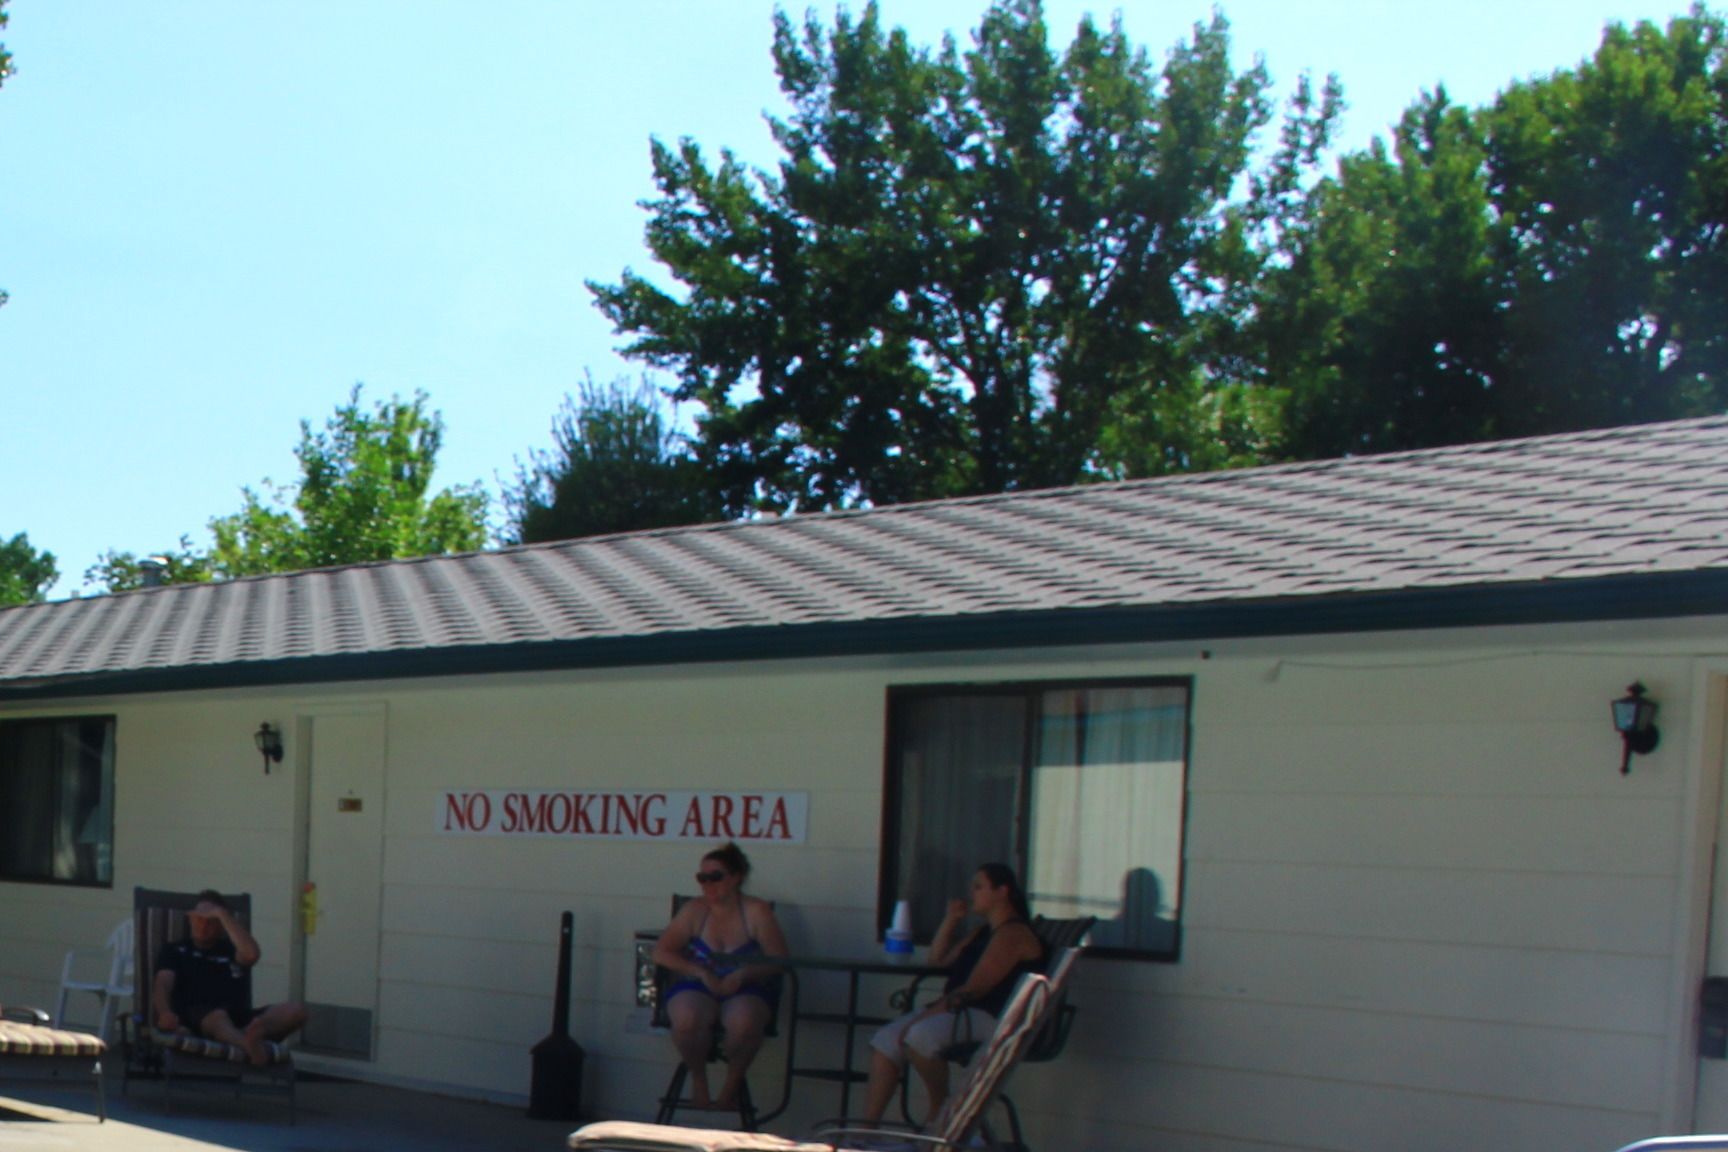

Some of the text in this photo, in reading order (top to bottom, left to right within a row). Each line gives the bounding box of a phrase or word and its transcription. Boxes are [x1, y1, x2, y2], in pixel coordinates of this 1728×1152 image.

[444, 792, 792, 840] NO SMOKING AREA
